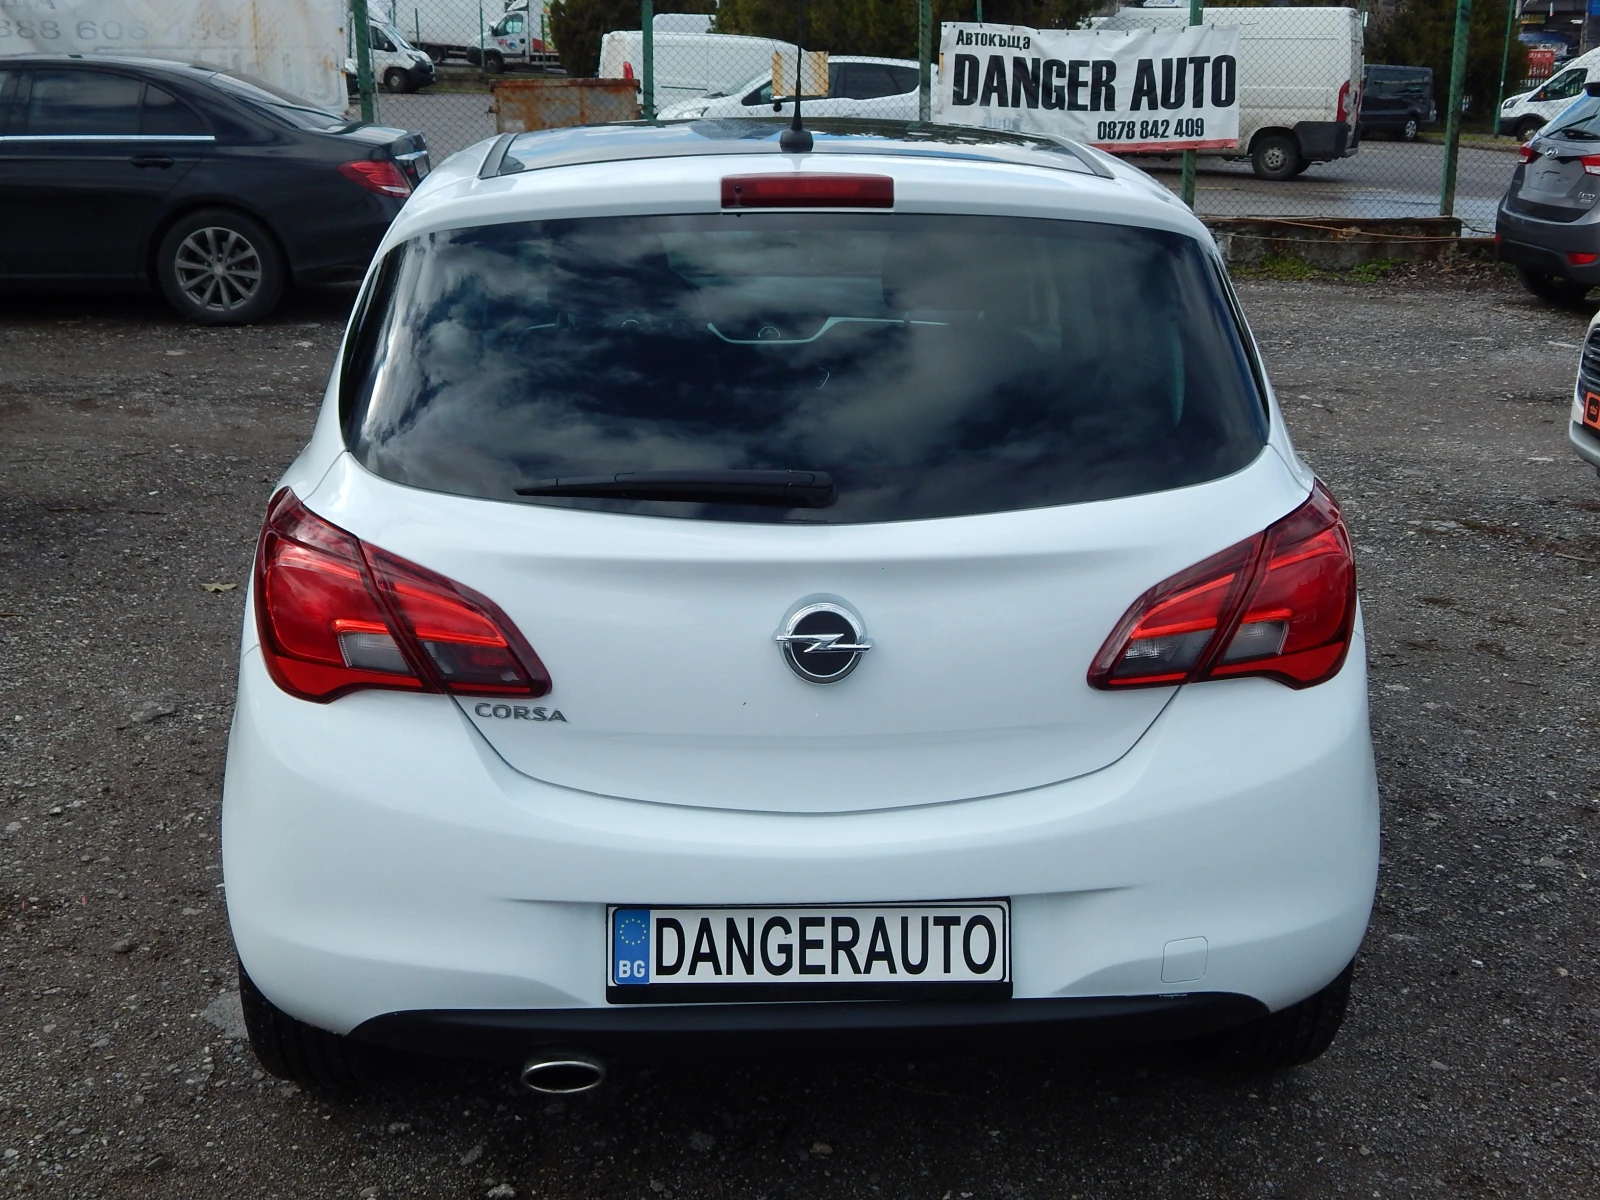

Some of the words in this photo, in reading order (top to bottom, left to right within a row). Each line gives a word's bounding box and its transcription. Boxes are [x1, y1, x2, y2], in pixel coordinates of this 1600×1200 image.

[76, 20, 148, 40] 606
[956, 29, 1031, 50] Автокъща
[952, 53, 1117, 111] DANGER
[1130, 55, 1236, 111] AUTO
[1097, 120, 1135, 140] 0878
[1139, 118, 1169, 139] 842
[1173, 117, 1205, 137] 409
[474, 702, 568, 722] CORSA
[618, 959, 645, 978] BG
[655, 914, 997, 976] DANGERAUTO
